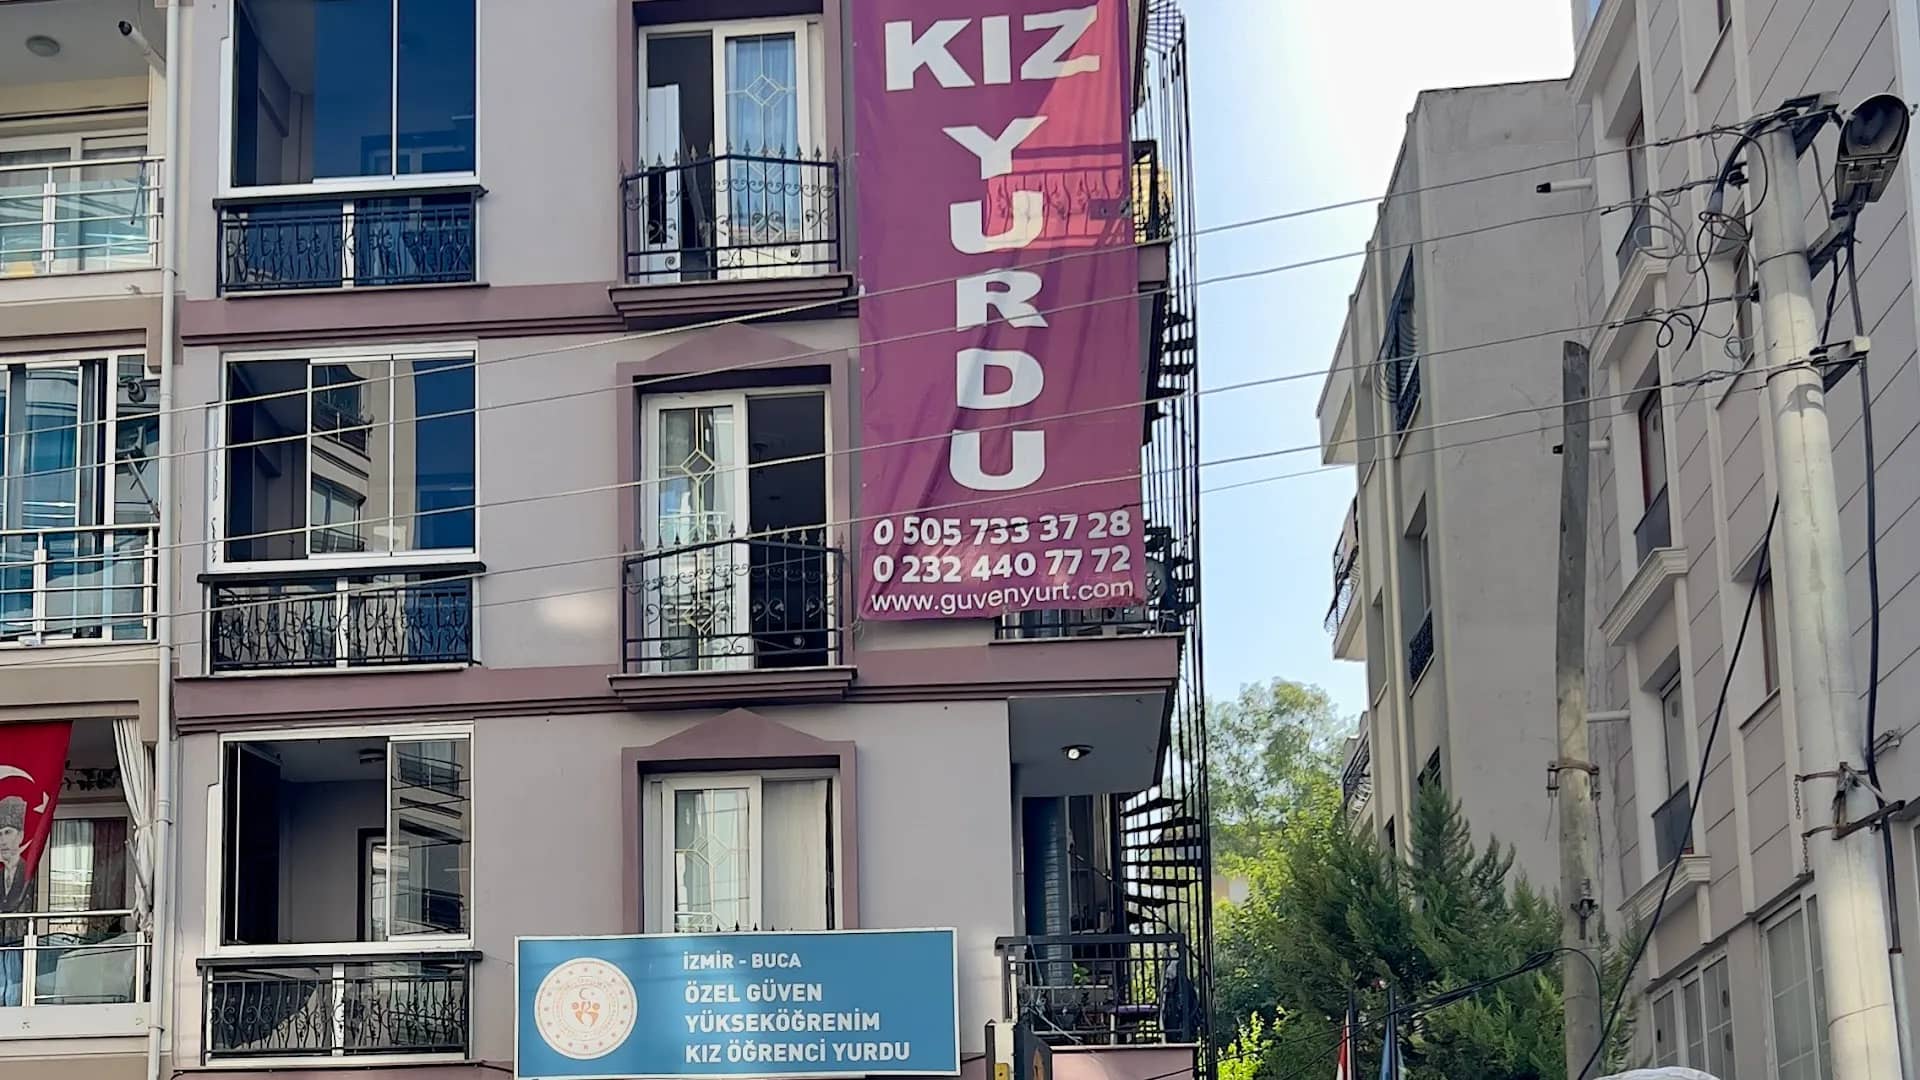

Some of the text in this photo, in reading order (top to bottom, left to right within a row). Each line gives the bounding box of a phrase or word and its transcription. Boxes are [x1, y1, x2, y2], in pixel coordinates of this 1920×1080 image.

[885, 5, 1100, 91] KIZ
[942, 116, 1048, 490] YURDU
[873, 511, 1131, 545] 0 505 733 37 28
[873, 545, 1131, 583] 0 232 440 77 72
[871, 580, 1134, 614] www.guvenyurt.com
[683, 950, 734, 970] İZMİR
[751, 952, 802, 969] BUCA
[685, 979, 822, 1003] ÖZEL GÜVEN
[685, 1008, 880, 1033] YÜKSEKÖĞRENİM
[685, 1039, 911, 1063] KIZ ÖĞRENCİ YURDU
